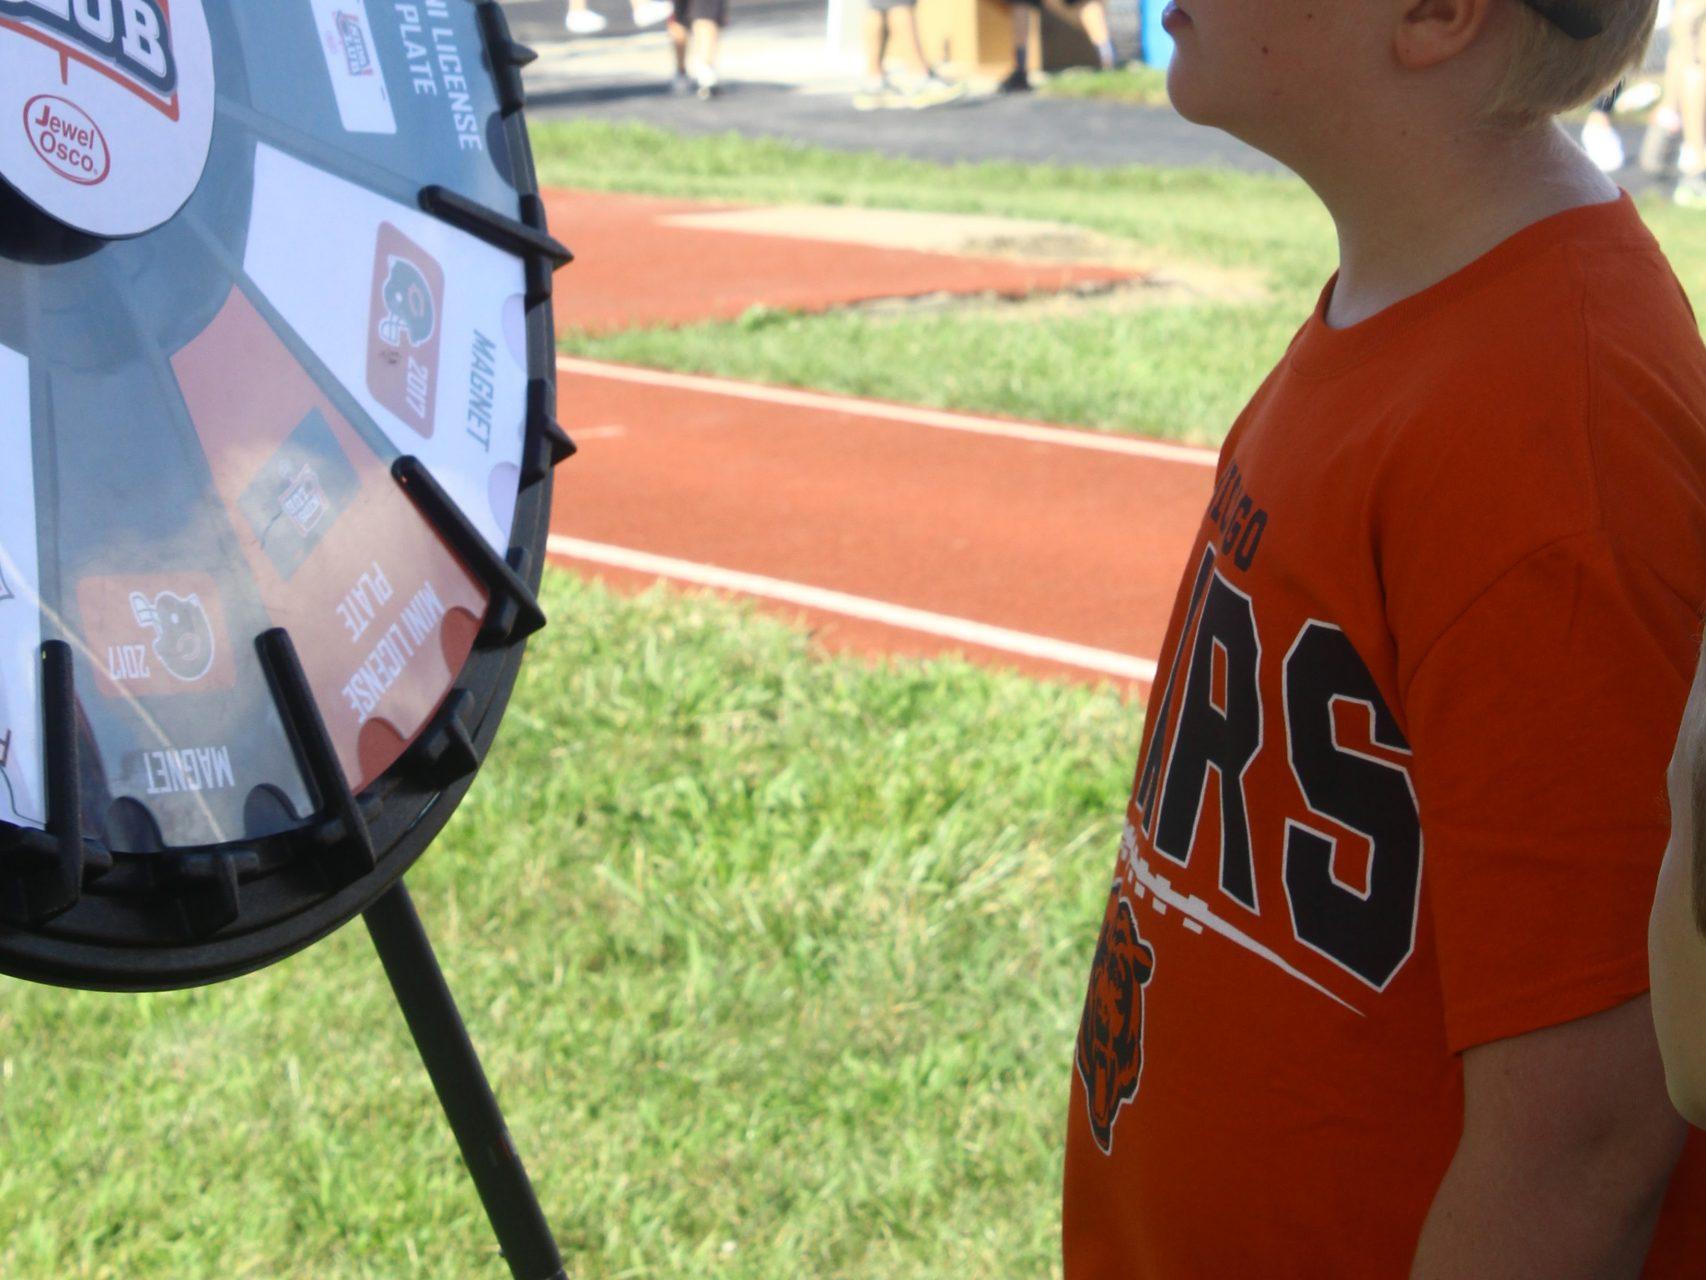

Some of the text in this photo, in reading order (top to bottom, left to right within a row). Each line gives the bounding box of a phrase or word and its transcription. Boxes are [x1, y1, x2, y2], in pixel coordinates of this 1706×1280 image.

[395, 3, 437, 96] PLATE
[432, 26, 483, 151] LICENSE
[35, 105, 95, 150] Jewel
[40, 130, 94, 173] Osco
[406, 356, 428, 418] 2017
[467, 329, 496, 453] MAGNET
[336, 560, 394, 643] PLATE
[108, 644, 150, 680] 2017
[341, 580, 445, 723] MINI LICENSE
[143, 745, 235, 794] MAGNET
[1135, 540, 1424, 993] ARS
